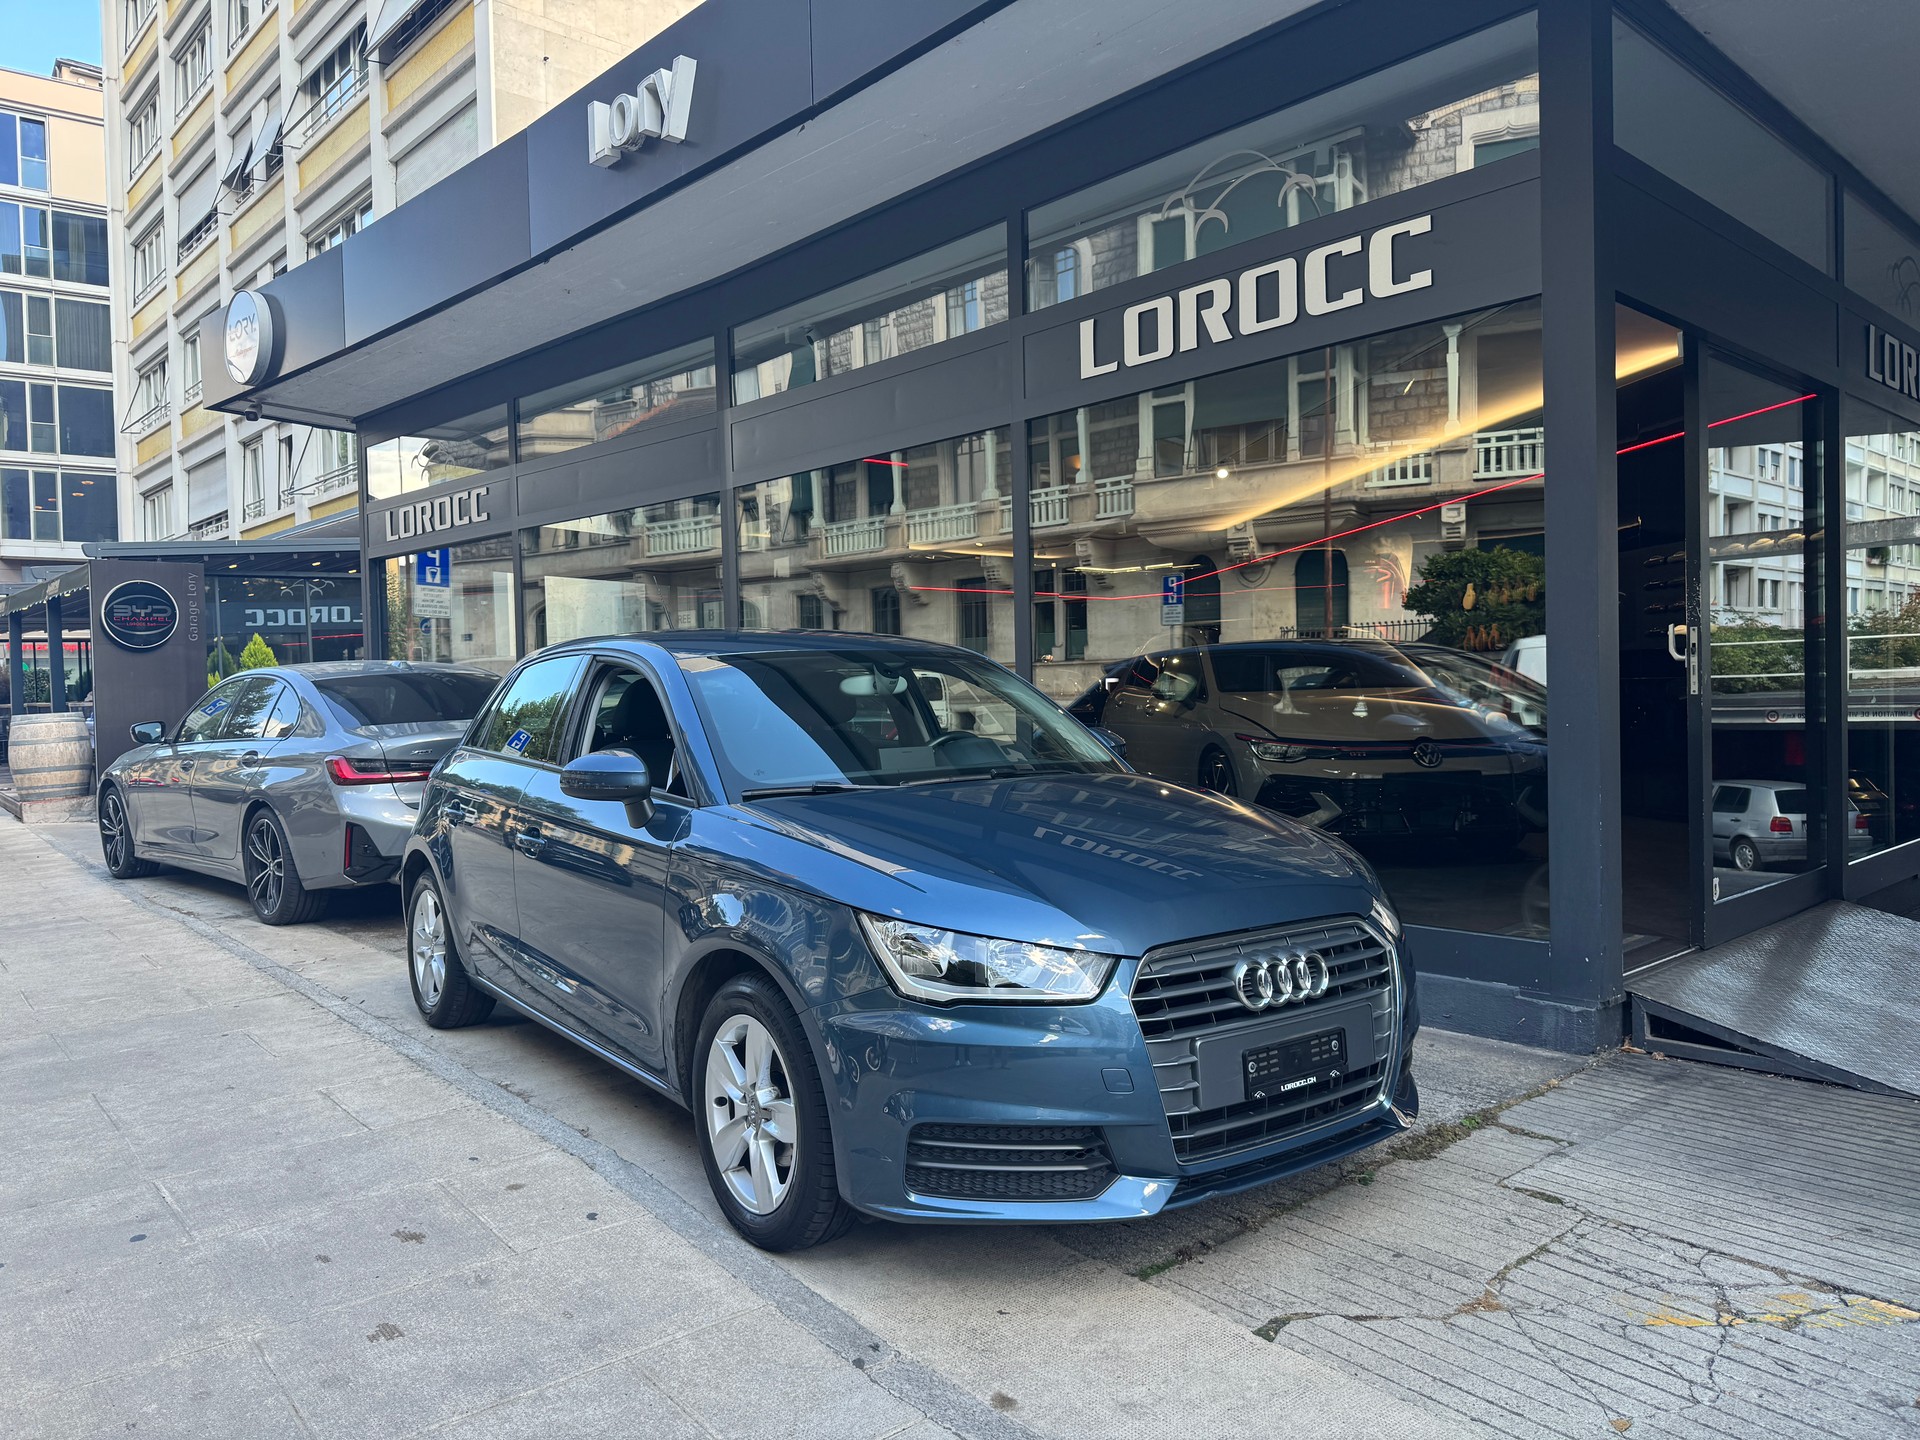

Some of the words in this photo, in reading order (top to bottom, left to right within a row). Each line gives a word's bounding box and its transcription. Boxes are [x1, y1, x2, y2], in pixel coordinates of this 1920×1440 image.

[1079, 214, 1432, 380] LOROCC
[1868, 323, 1920, 400] LOR
[385, 486, 489, 542] LOROCC
[187, 572, 198, 596] Lory
[113, 605, 172, 617] BYD
[188, 600, 200, 641] Garage
[1281, 1076, 1317, 1092] LOROCC.CH
